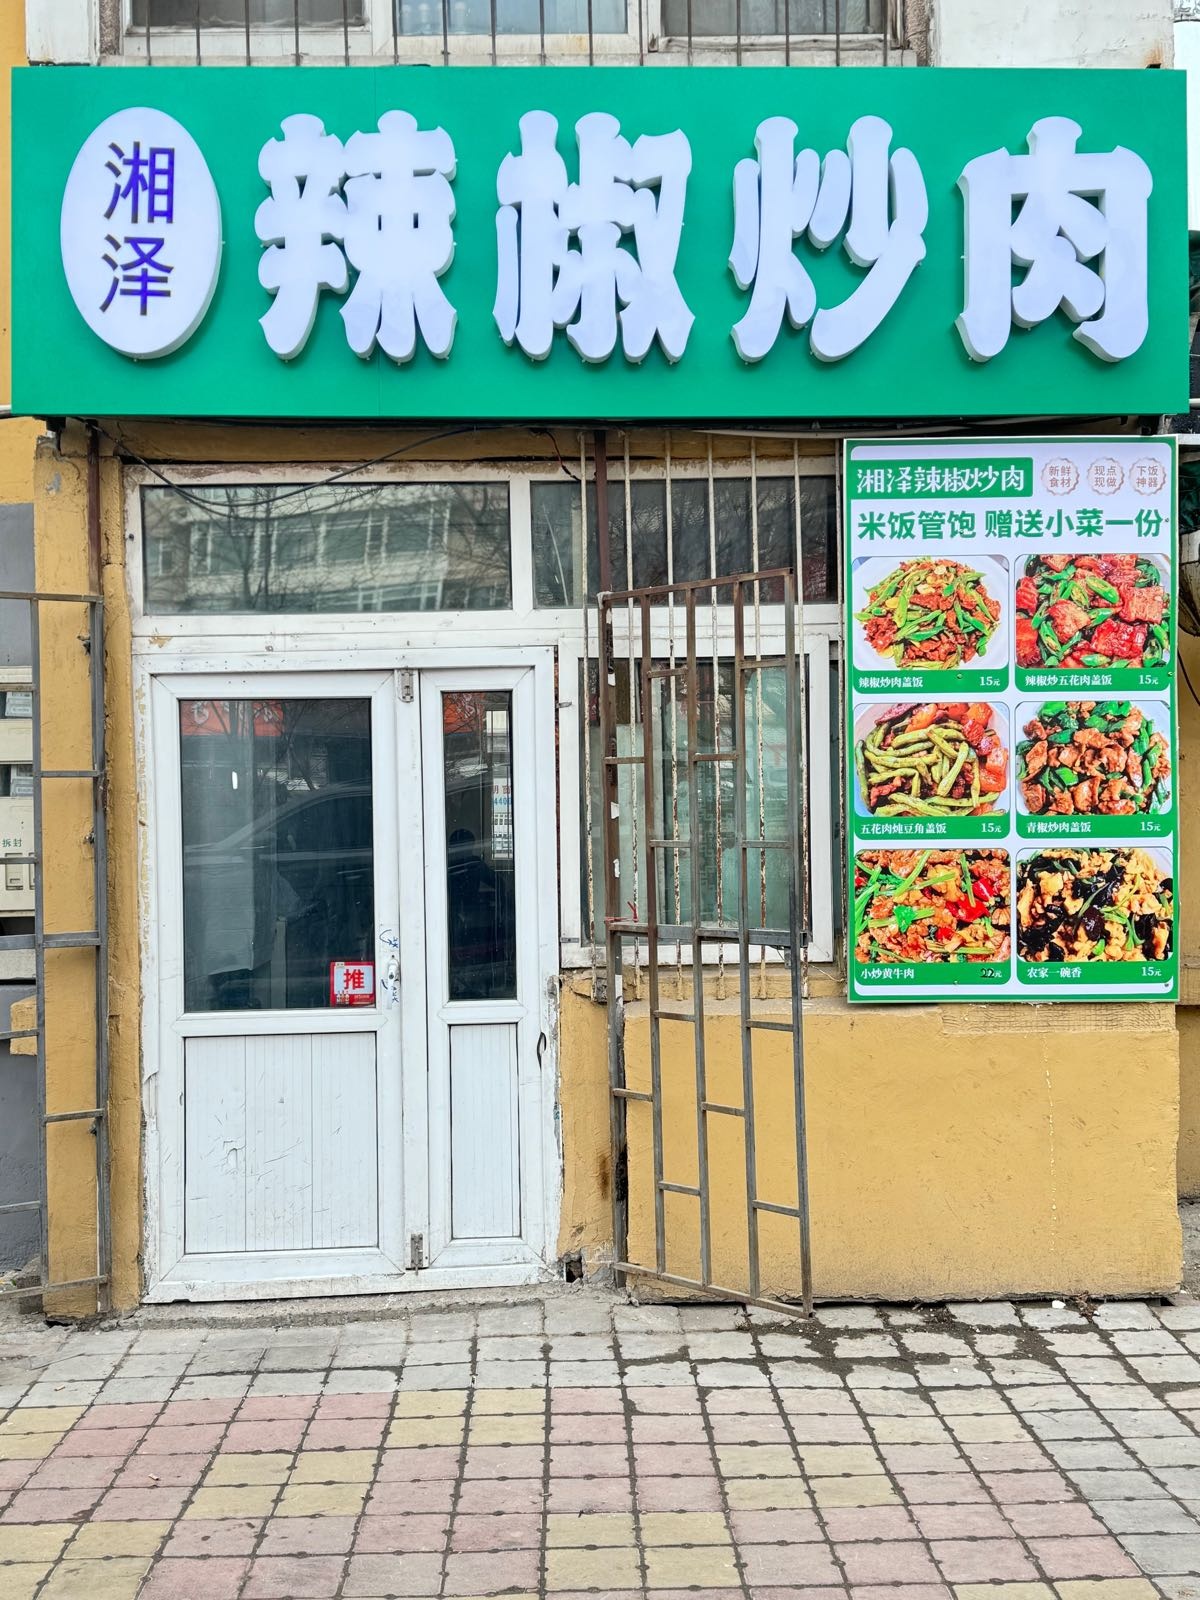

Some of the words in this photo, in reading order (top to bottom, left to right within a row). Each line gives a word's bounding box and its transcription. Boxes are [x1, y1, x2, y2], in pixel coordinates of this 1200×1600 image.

[99, 141, 175, 316] 湘泽
[255, 110, 1153, 363] 辣椒炒肉
[1049, 465, 1071, 477] 新鲜
[1094, 465, 1117, 476] 现点
[1136, 465, 1158, 476] 下饭
[857, 465, 1024, 494] 湘泽辣椒炒肉
[1049, 477, 1071, 488] 食材
[1094, 477, 1117, 488] 现做
[1136, 477, 1158, 488] 神器
[857, 510, 976, 540] 米饭管饱
[985, 508, 1163, 538] 赠送小菜一份
[858, 676, 924, 688] 辣椒炒肉盖饭
[979, 676, 1001, 686] 15元
[1025, 674, 1112, 686] 辣椒炒五花肉盖饭
[1138, 674, 1159, 685] 15元
[860, 822, 947, 835] 五花肉炖豆角盖饭
[981, 822, 1002, 833] 15元
[1026, 821, 1092, 833] 青椒炒肉盖饭
[1140, 821, 1161, 831] 15元
[860, 968, 915, 980] 小炒黄牛肉
[1027, 966, 1082, 979] 农家一碗香
[1141, 966, 1162, 977] 15元
[343, 968, 365, 990] 推
